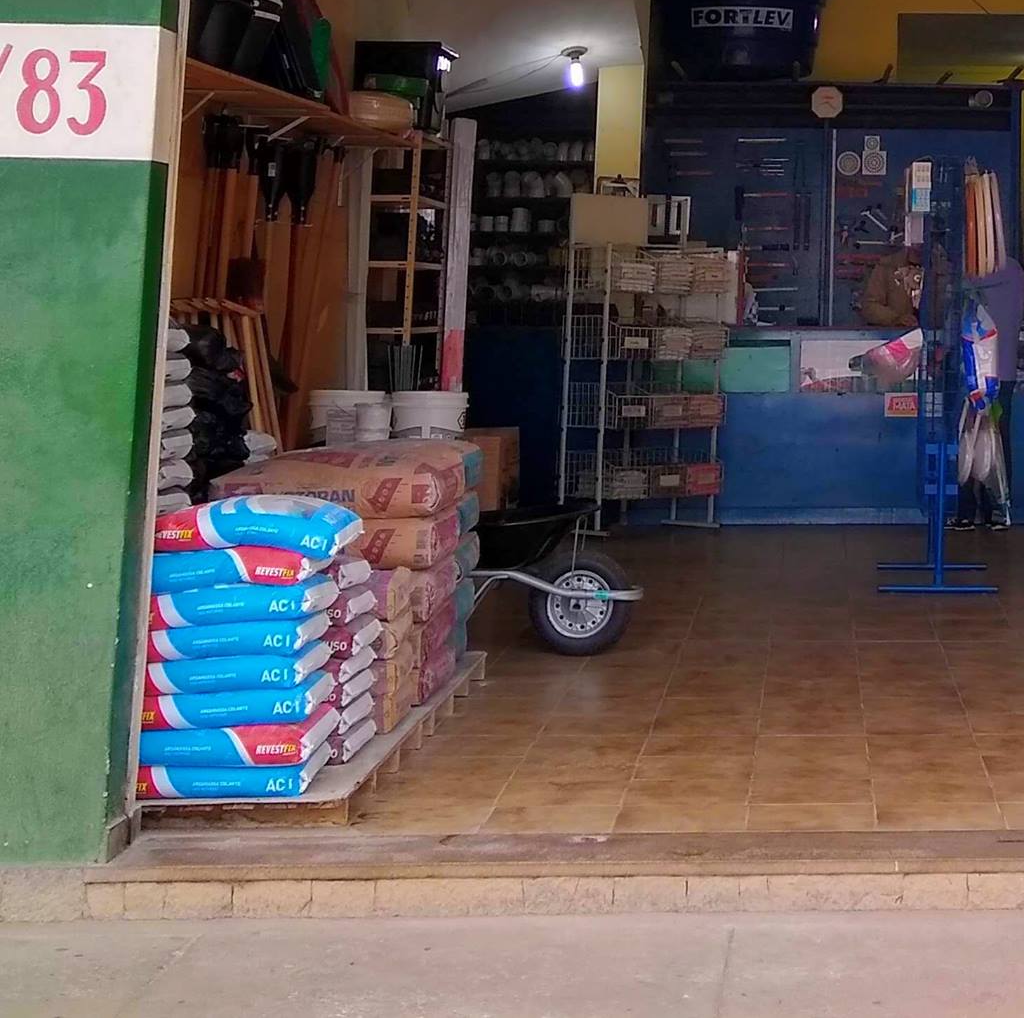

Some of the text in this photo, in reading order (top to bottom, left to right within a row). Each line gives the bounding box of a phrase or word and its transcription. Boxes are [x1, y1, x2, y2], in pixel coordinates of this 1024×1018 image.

[693, 8, 790, 26] FORTLEV
[300, 535, 320, 549] AC
[255, 566, 296, 579] REVESTFIX
[269, 599, 288, 612] AC
[263, 635, 284, 647] AC
[261, 669, 281, 682] AC
[273, 701, 293, 715] AC
[256, 743, 297, 755] REVESTFIX
[265, 779, 286, 792] AC
